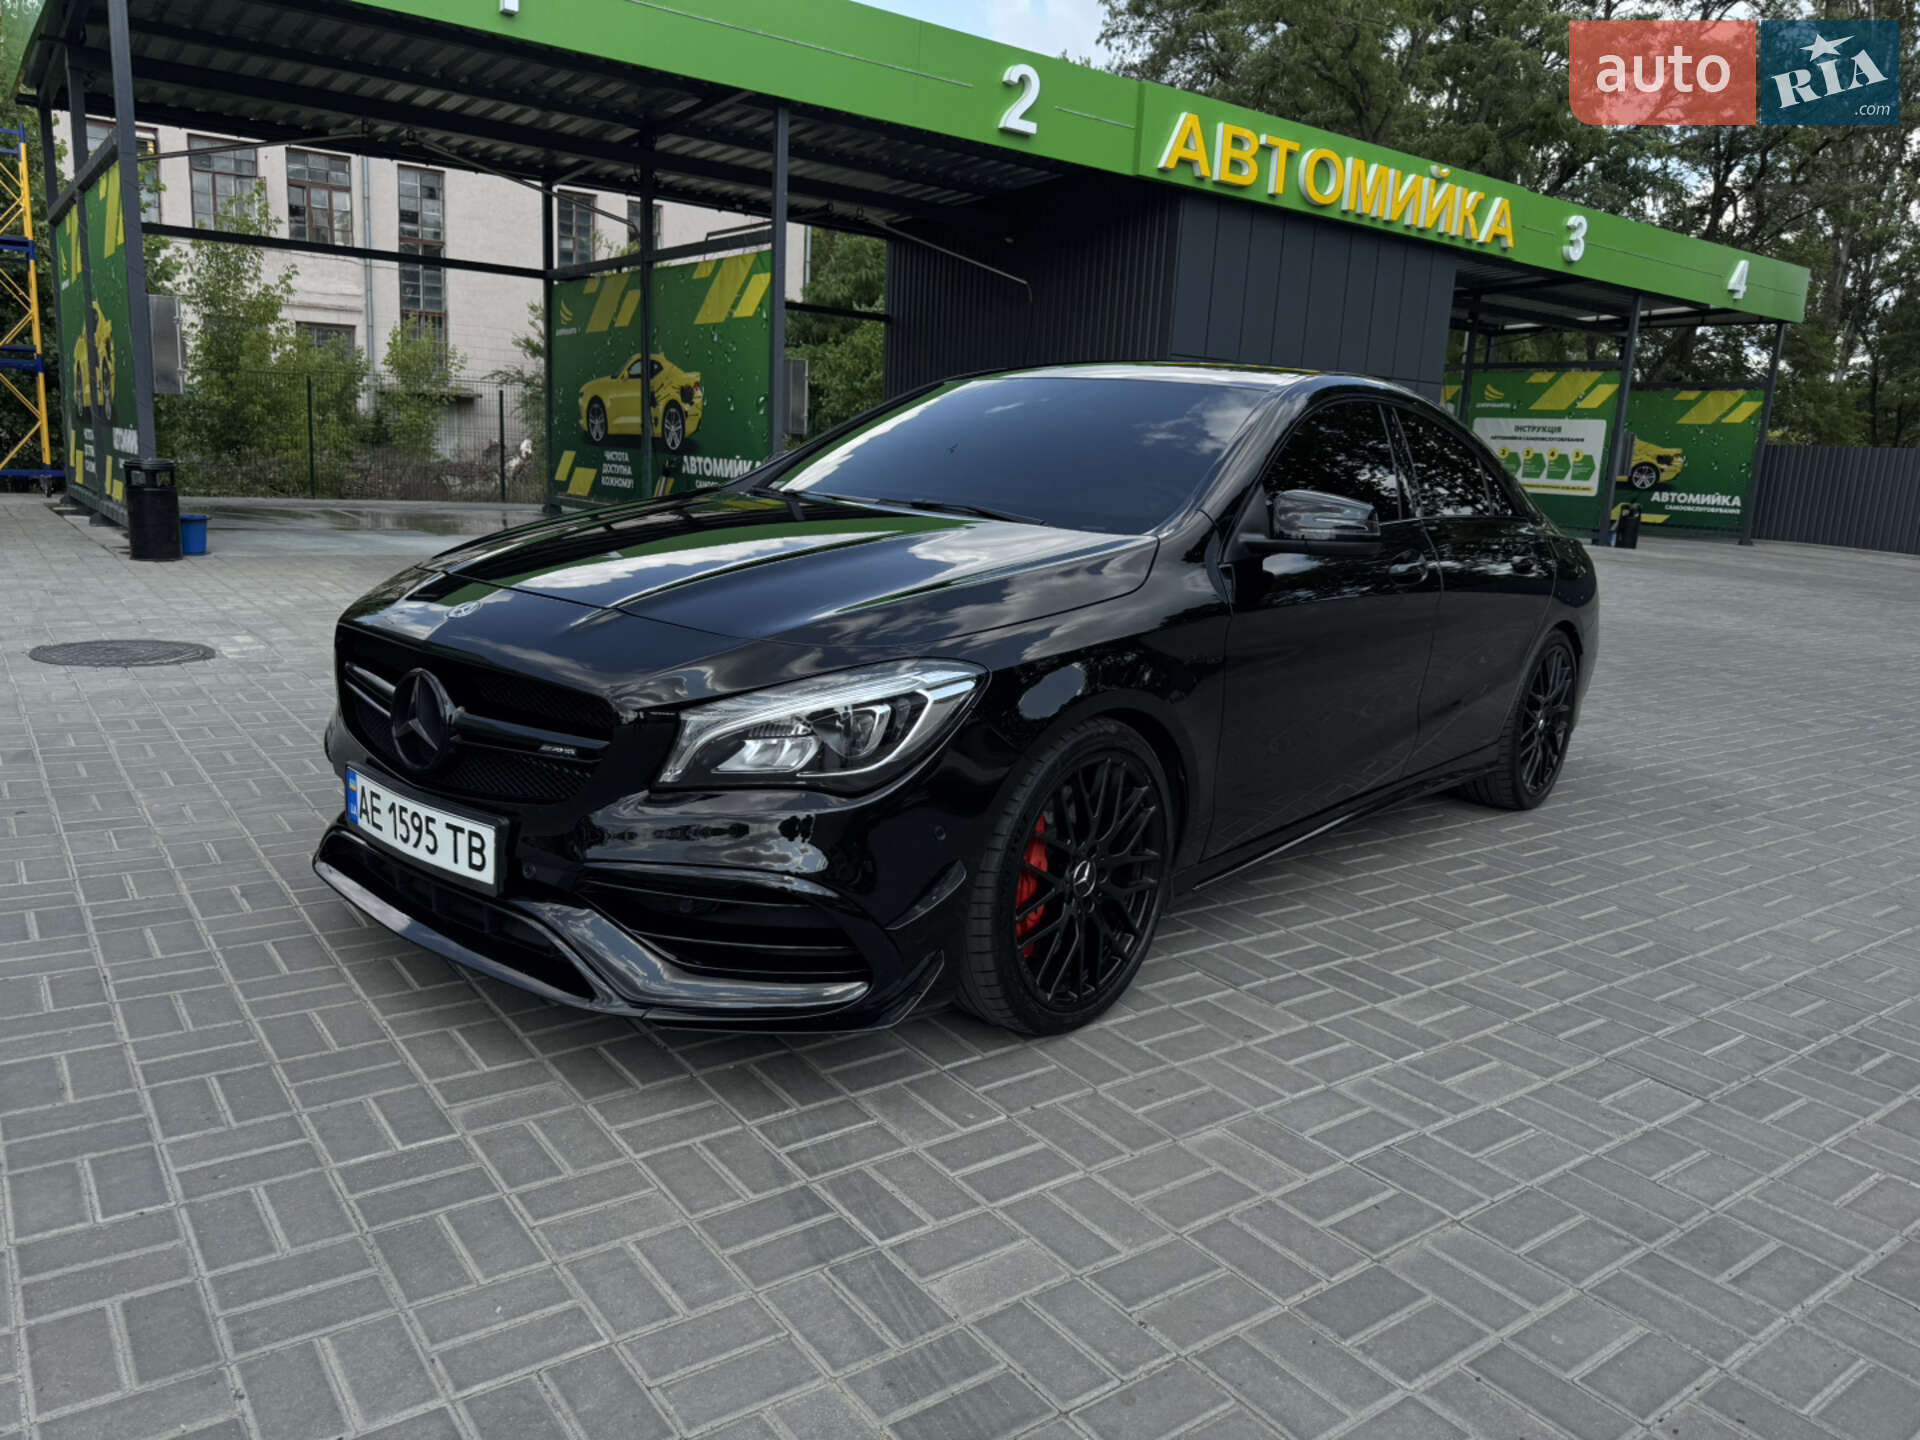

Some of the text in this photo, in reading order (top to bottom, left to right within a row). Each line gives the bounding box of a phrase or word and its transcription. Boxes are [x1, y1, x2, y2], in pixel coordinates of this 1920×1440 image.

[998, 64, 1040, 136] 2
[1157, 112, 1514, 248] АВТОМИЙКА
[1563, 215, 1588, 262] 3
[1728, 259, 1749, 300] 4
[1651, 491, 1741, 507] АВТОМИЙКА
[359, 785, 486, 872] AE 1595 TB
